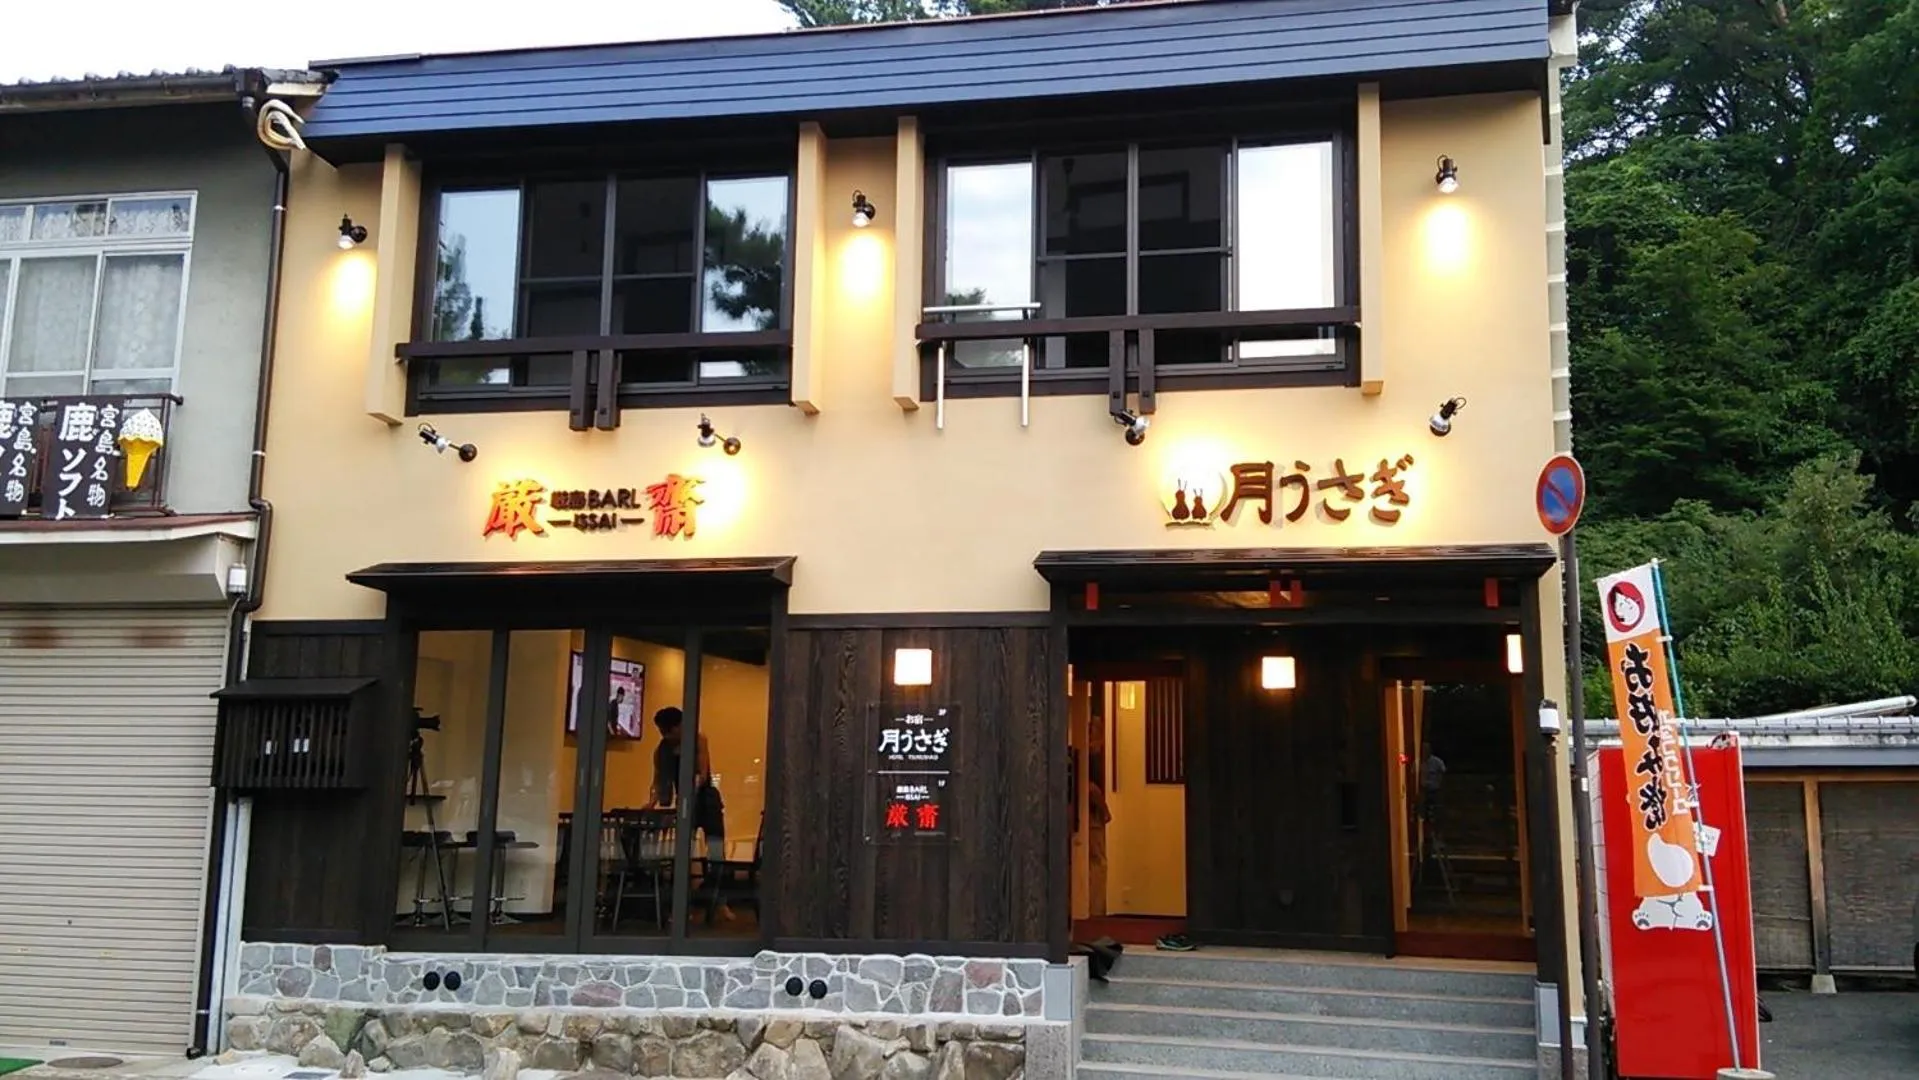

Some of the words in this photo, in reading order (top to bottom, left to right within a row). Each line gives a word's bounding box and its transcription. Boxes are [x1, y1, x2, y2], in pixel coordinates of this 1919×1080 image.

[5, 402, 37, 502] 宮島名物
[55, 403, 97, 520] 鹿ソフト
[87, 404, 120, 507] 宮島名物
[1220, 454, 1414, 524] 月うさぎ
[574, 513, 617, 532] ISSAI
[878, 727, 950, 753] 月うさぎ
